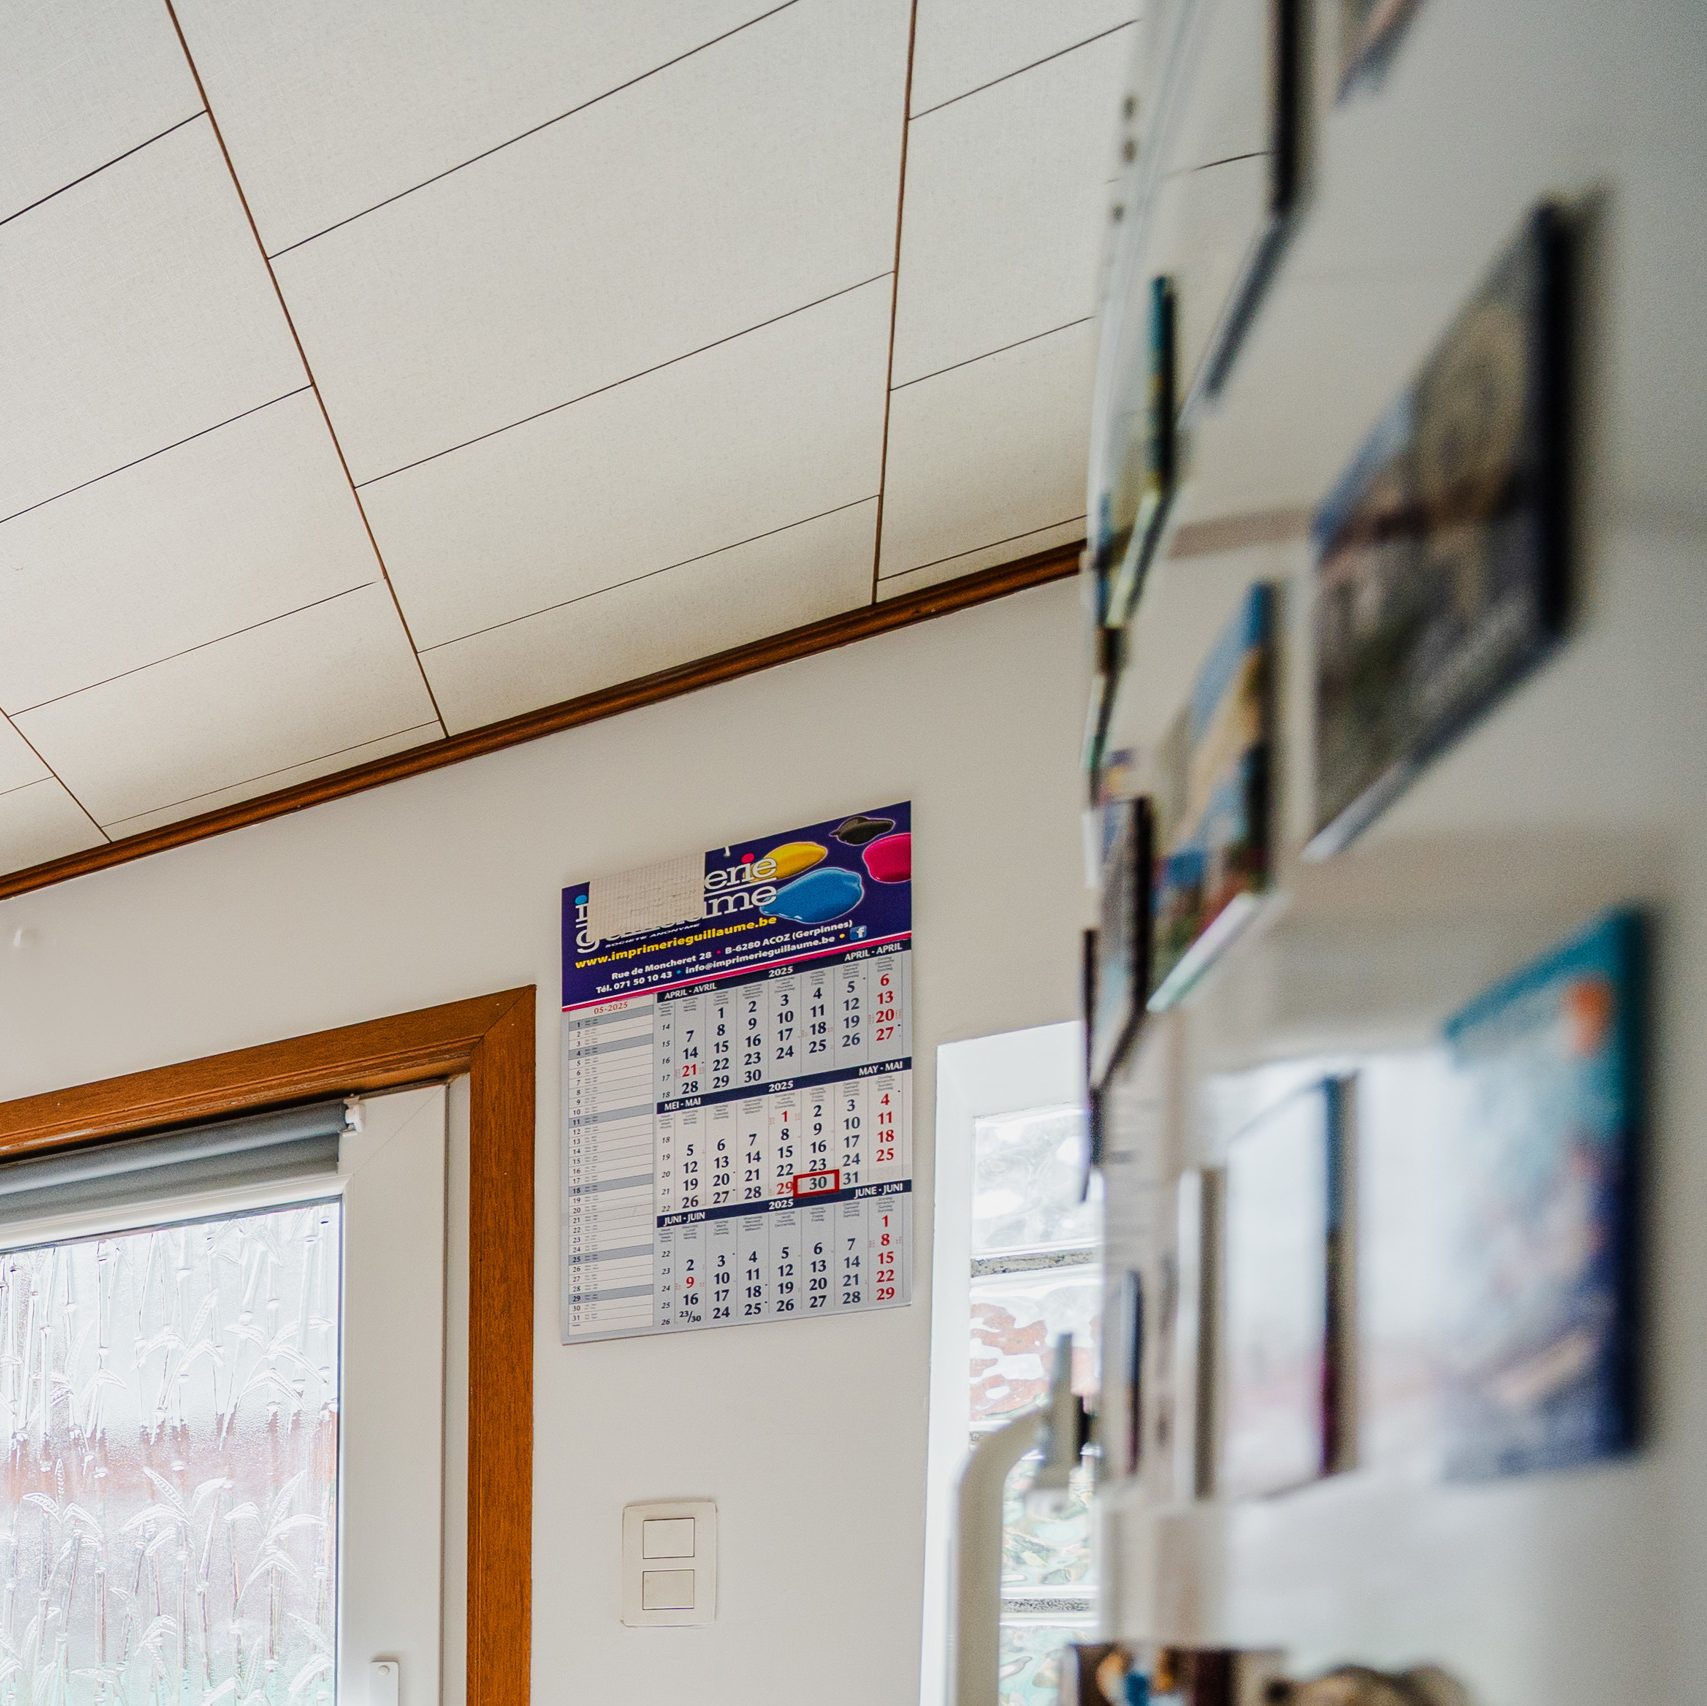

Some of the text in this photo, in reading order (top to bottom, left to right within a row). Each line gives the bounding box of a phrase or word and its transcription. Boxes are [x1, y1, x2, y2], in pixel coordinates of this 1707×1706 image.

[575, 917, 777, 969] www.imprimerieguillaume.be
[596, 985, 612, 994] Tél.
[614, 980, 631, 990] 071
[633, 977, 645, 986] 50
[647, 974, 659, 983] 10
[660, 971, 673, 979] 43
[685, 936, 835, 973] info@imprimerieguillaume.be
[611, 920, 853, 980] Rue de Moncheret 28 B-6280 ACOZ (Gerpinnes)
[664, 942, 903, 1000] APRIL AVRIL 2025 APRIL APRIL
[593, 1001, 628, 1015] 05-2025
[661, 973, 890, 1031] 14 1 2 3 4 5 6
[661, 990, 894, 1048] 15 7 8 9 10 11 12 13
[661, 1008, 895, 1065] 16 14 15 16 17 18 19 20
[661, 1026, 894, 1082] 17 21 22 23 24 25 26 27
[661, 1069, 762, 1099] 18 28 29 30
[664, 1061, 903, 1111] MEI MAI 2025 MAY MAI
[661, 1093, 890, 1144] 18 1 2 3 4
[661, 1111, 892, 1161] 19 5 6 7 8 9 10 11
[661, 1129, 894, 1178] 20 12 13 14 15 16 17 18
[683, 1178, 698, 1191] 19
[713, 1173, 730, 1187] 20
[745, 1168, 759, 1182] 21
[776, 1163, 794, 1177] 22
[809, 1158, 827, 1173] 23
[843, 1153, 861, 1167] 24
[876, 1147, 894, 1162] 25
[661, 1171, 858, 1213] 22 26 27 28 29 30 31
[663, 1183, 903, 1226] JUNI JUIN 2025 JUNE JUNI
[661, 1215, 888, 1258] 22 1
[661, 1233, 890, 1276] 23 2 3 4 5 6 7 8
[661, 1251, 894, 1293] 24 9 10 11 12 13 14 15
[661, 1269, 894, 1309] 25 16 17 18 19 20 21 22
[661, 1318, 671, 1326] 26
[713, 1306, 730, 1319] 24
[744, 1302, 761, 1316] 25
[776, 1298, 794, 1312] 26
[809, 1295, 827, 1308] 27
[842, 1291, 861, 1304] 28
[876, 1287, 895, 1301] 29
